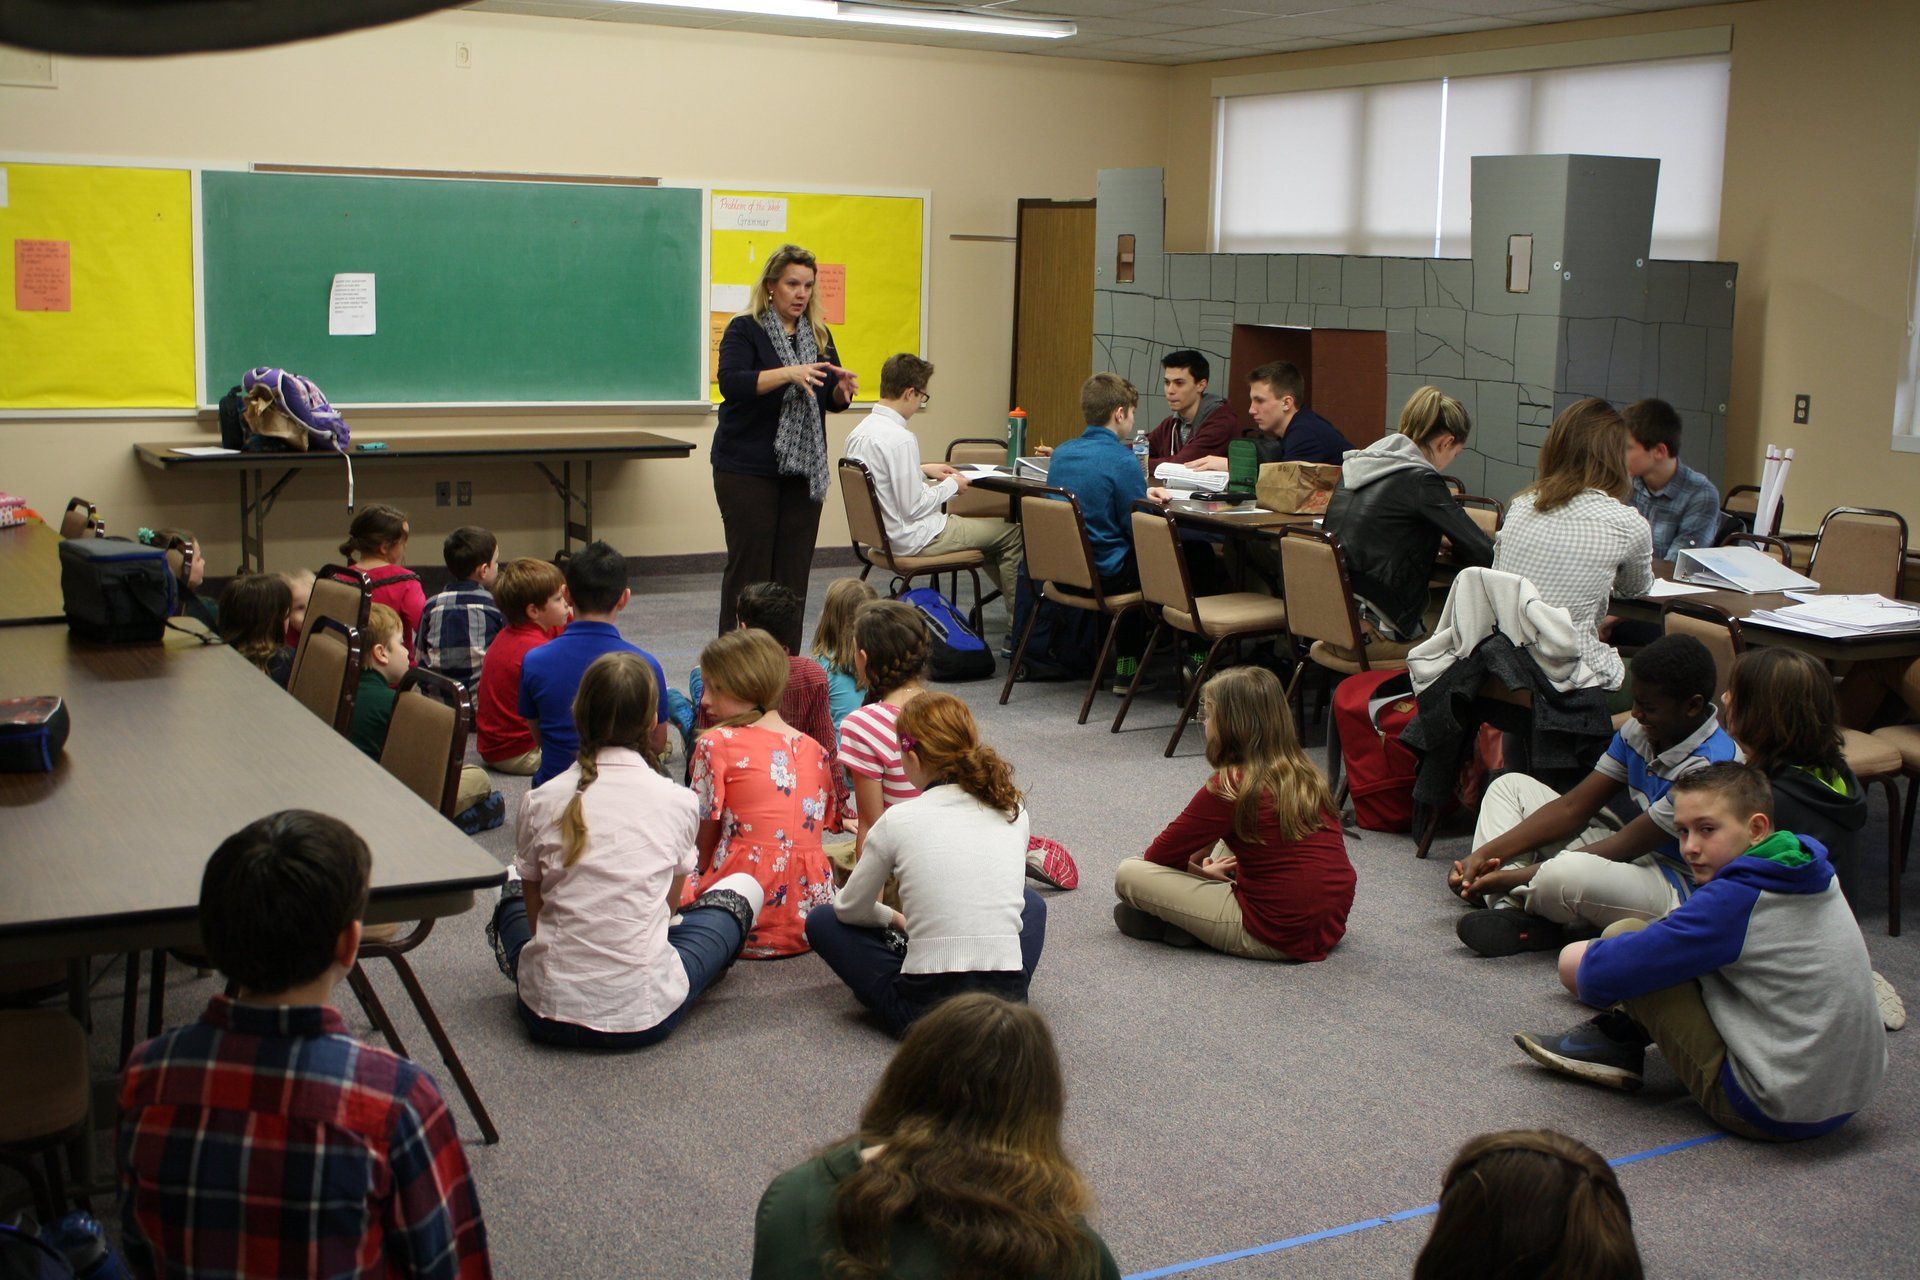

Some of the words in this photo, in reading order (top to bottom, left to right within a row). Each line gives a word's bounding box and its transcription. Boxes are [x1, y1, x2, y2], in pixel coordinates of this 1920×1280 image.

[719, 197, 746, 210] Problem
[746, 199, 755, 214] of
[755, 200, 766, 211] the
[737, 214, 769, 226] Grammar
